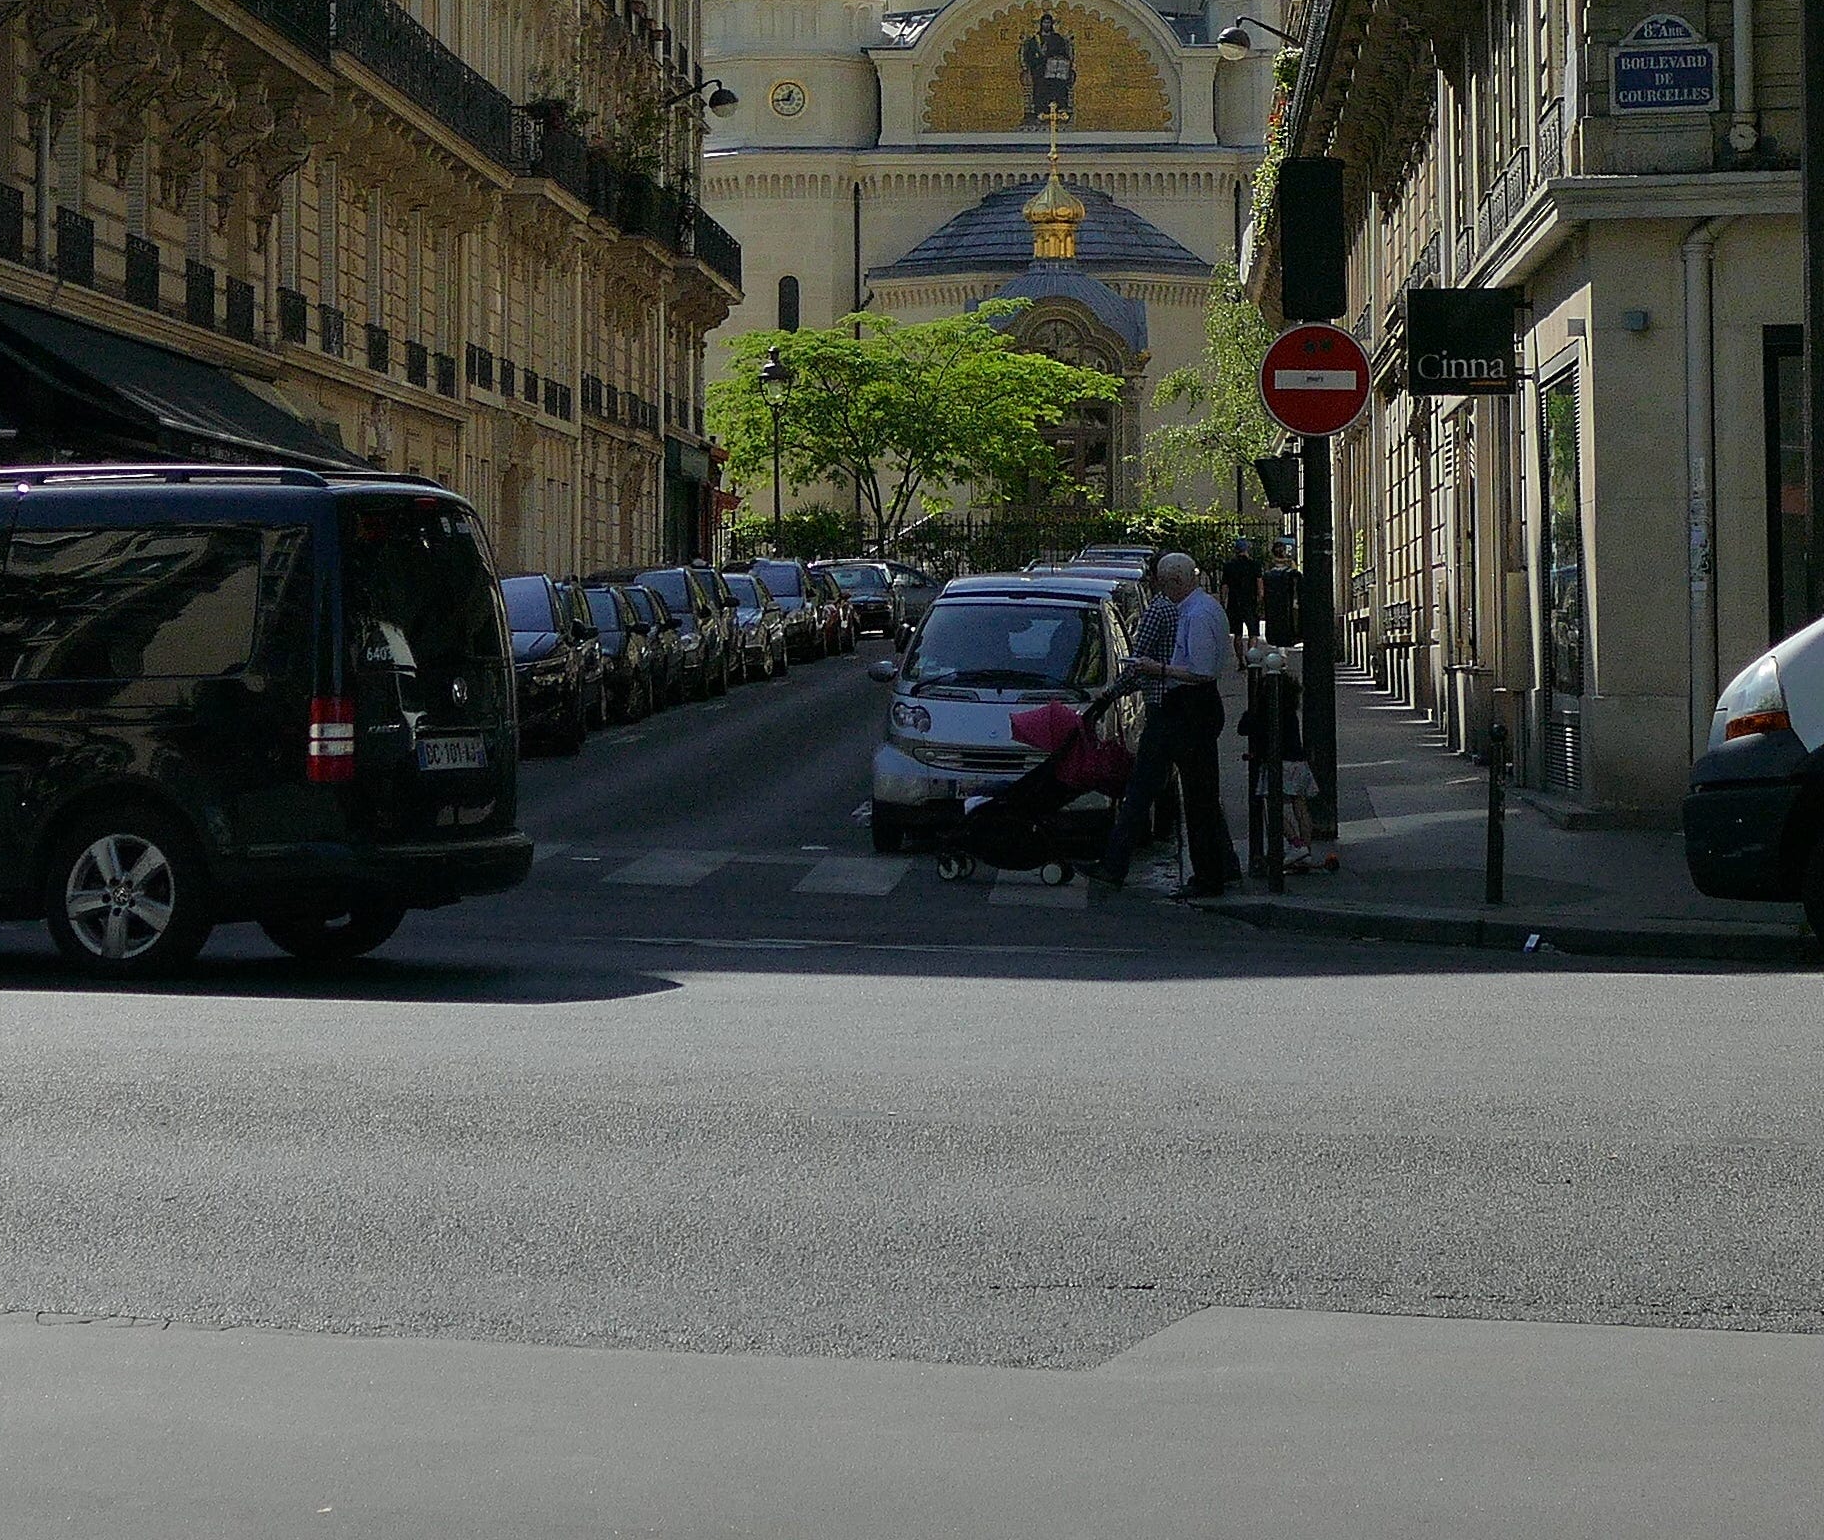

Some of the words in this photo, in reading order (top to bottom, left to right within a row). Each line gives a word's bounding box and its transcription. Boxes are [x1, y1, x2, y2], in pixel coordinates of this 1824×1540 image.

[1620, 55, 1707, 71] BOULEVARD
[1654, 72, 1675, 86] DE
[1618, 87, 1712, 103] COURCELLES
[1417, 349, 1508, 380] Cinna
